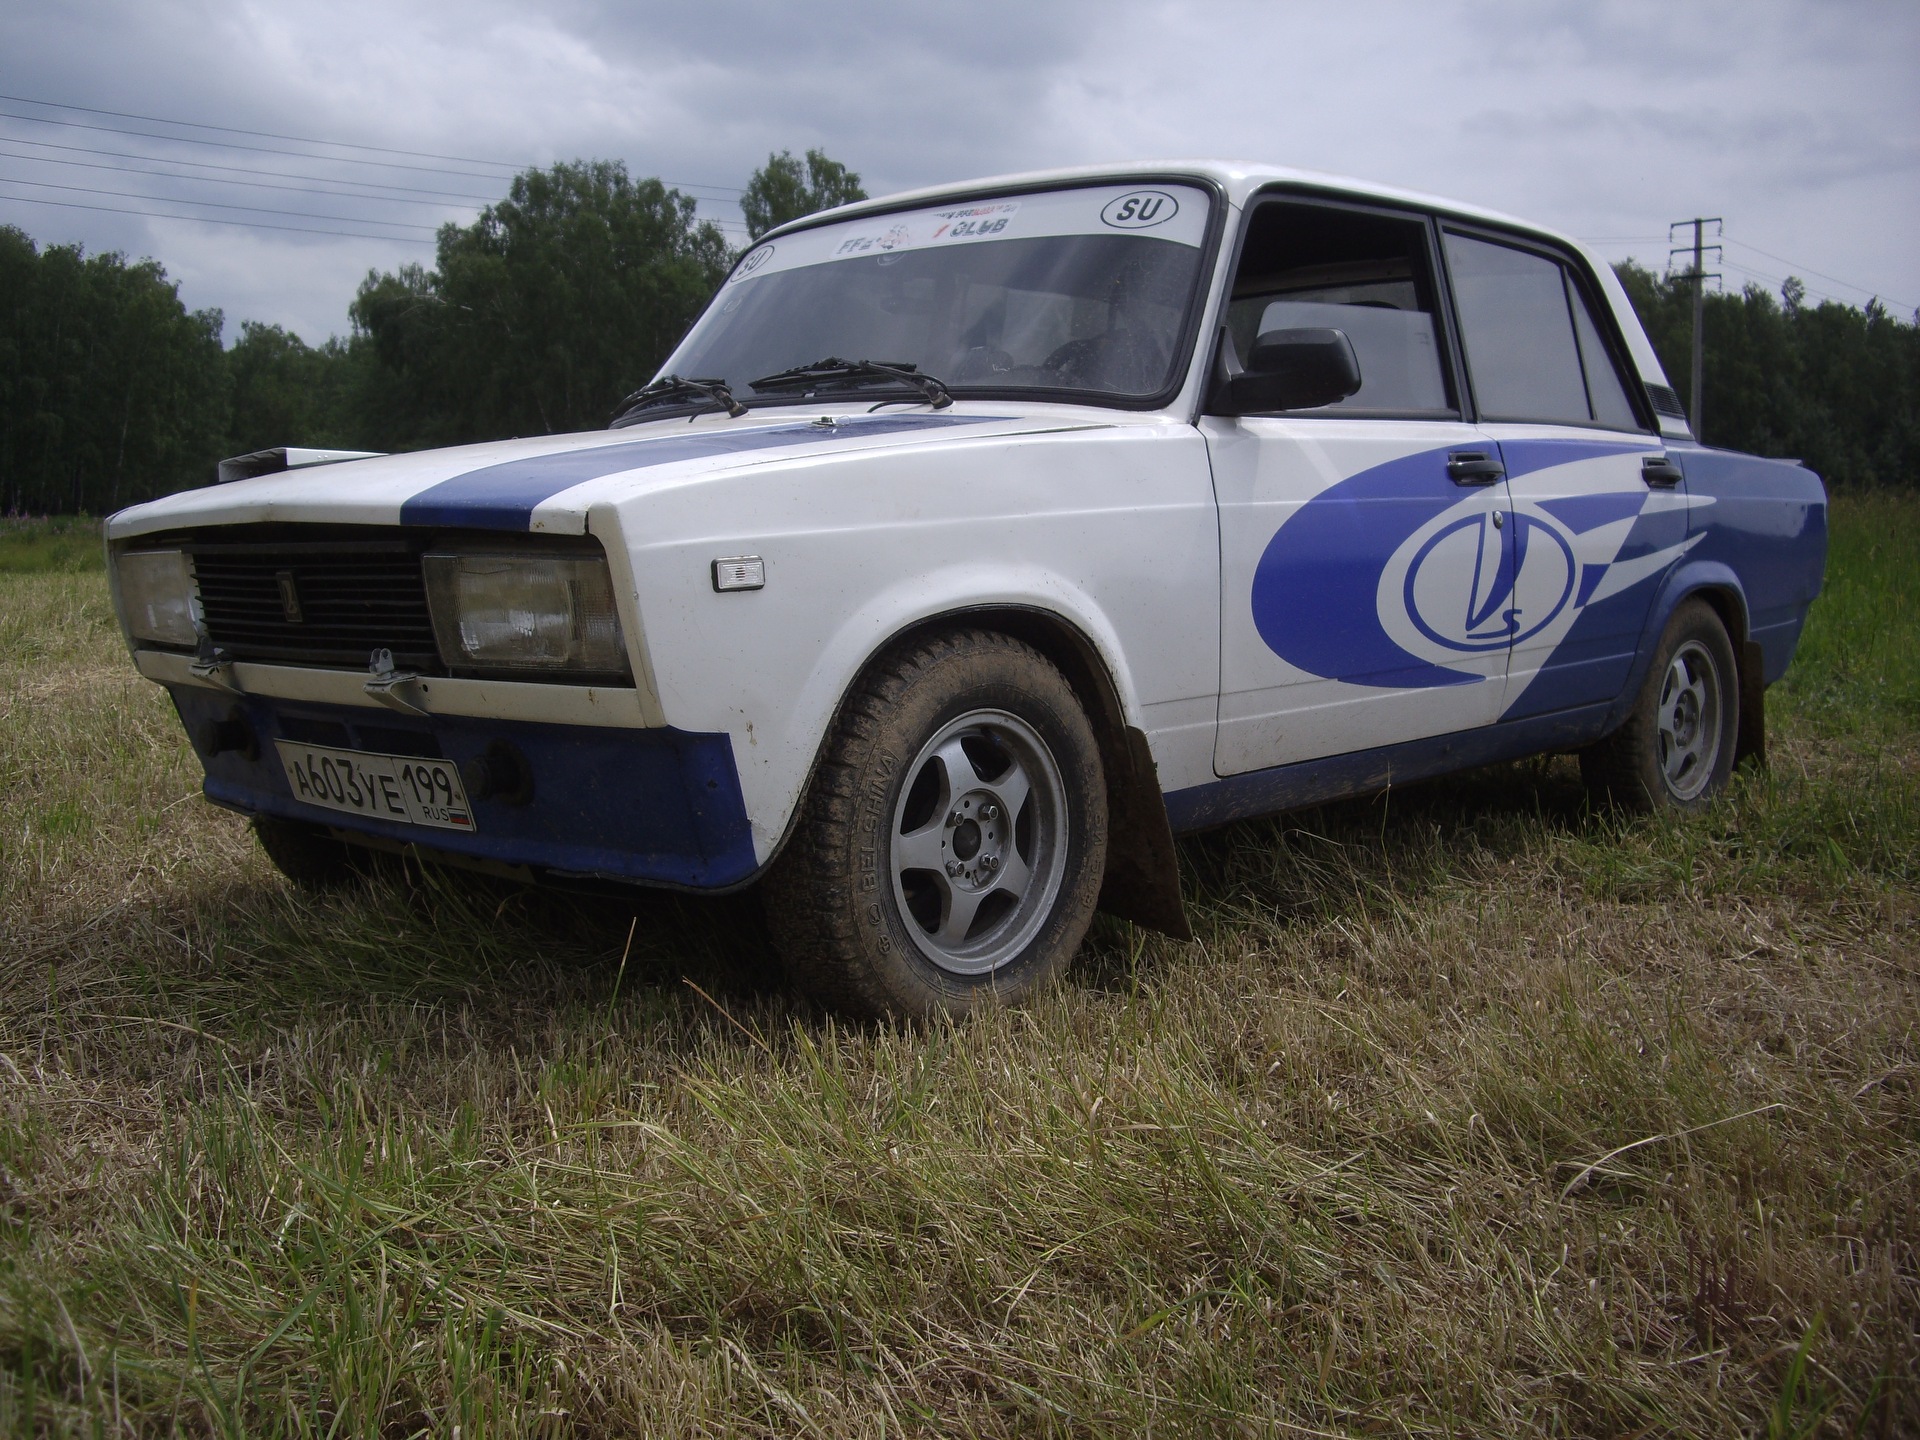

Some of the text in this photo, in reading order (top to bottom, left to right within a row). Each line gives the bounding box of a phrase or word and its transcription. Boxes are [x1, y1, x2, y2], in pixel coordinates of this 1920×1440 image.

[1116, 198, 1164, 221] SU
[950, 219, 1009, 237] CLUB
[737, 249, 768, 276] SU
[402, 764, 453, 806] 199
[422, 805, 450, 821] RUS
[860, 753, 897, 892] BELSHINA
